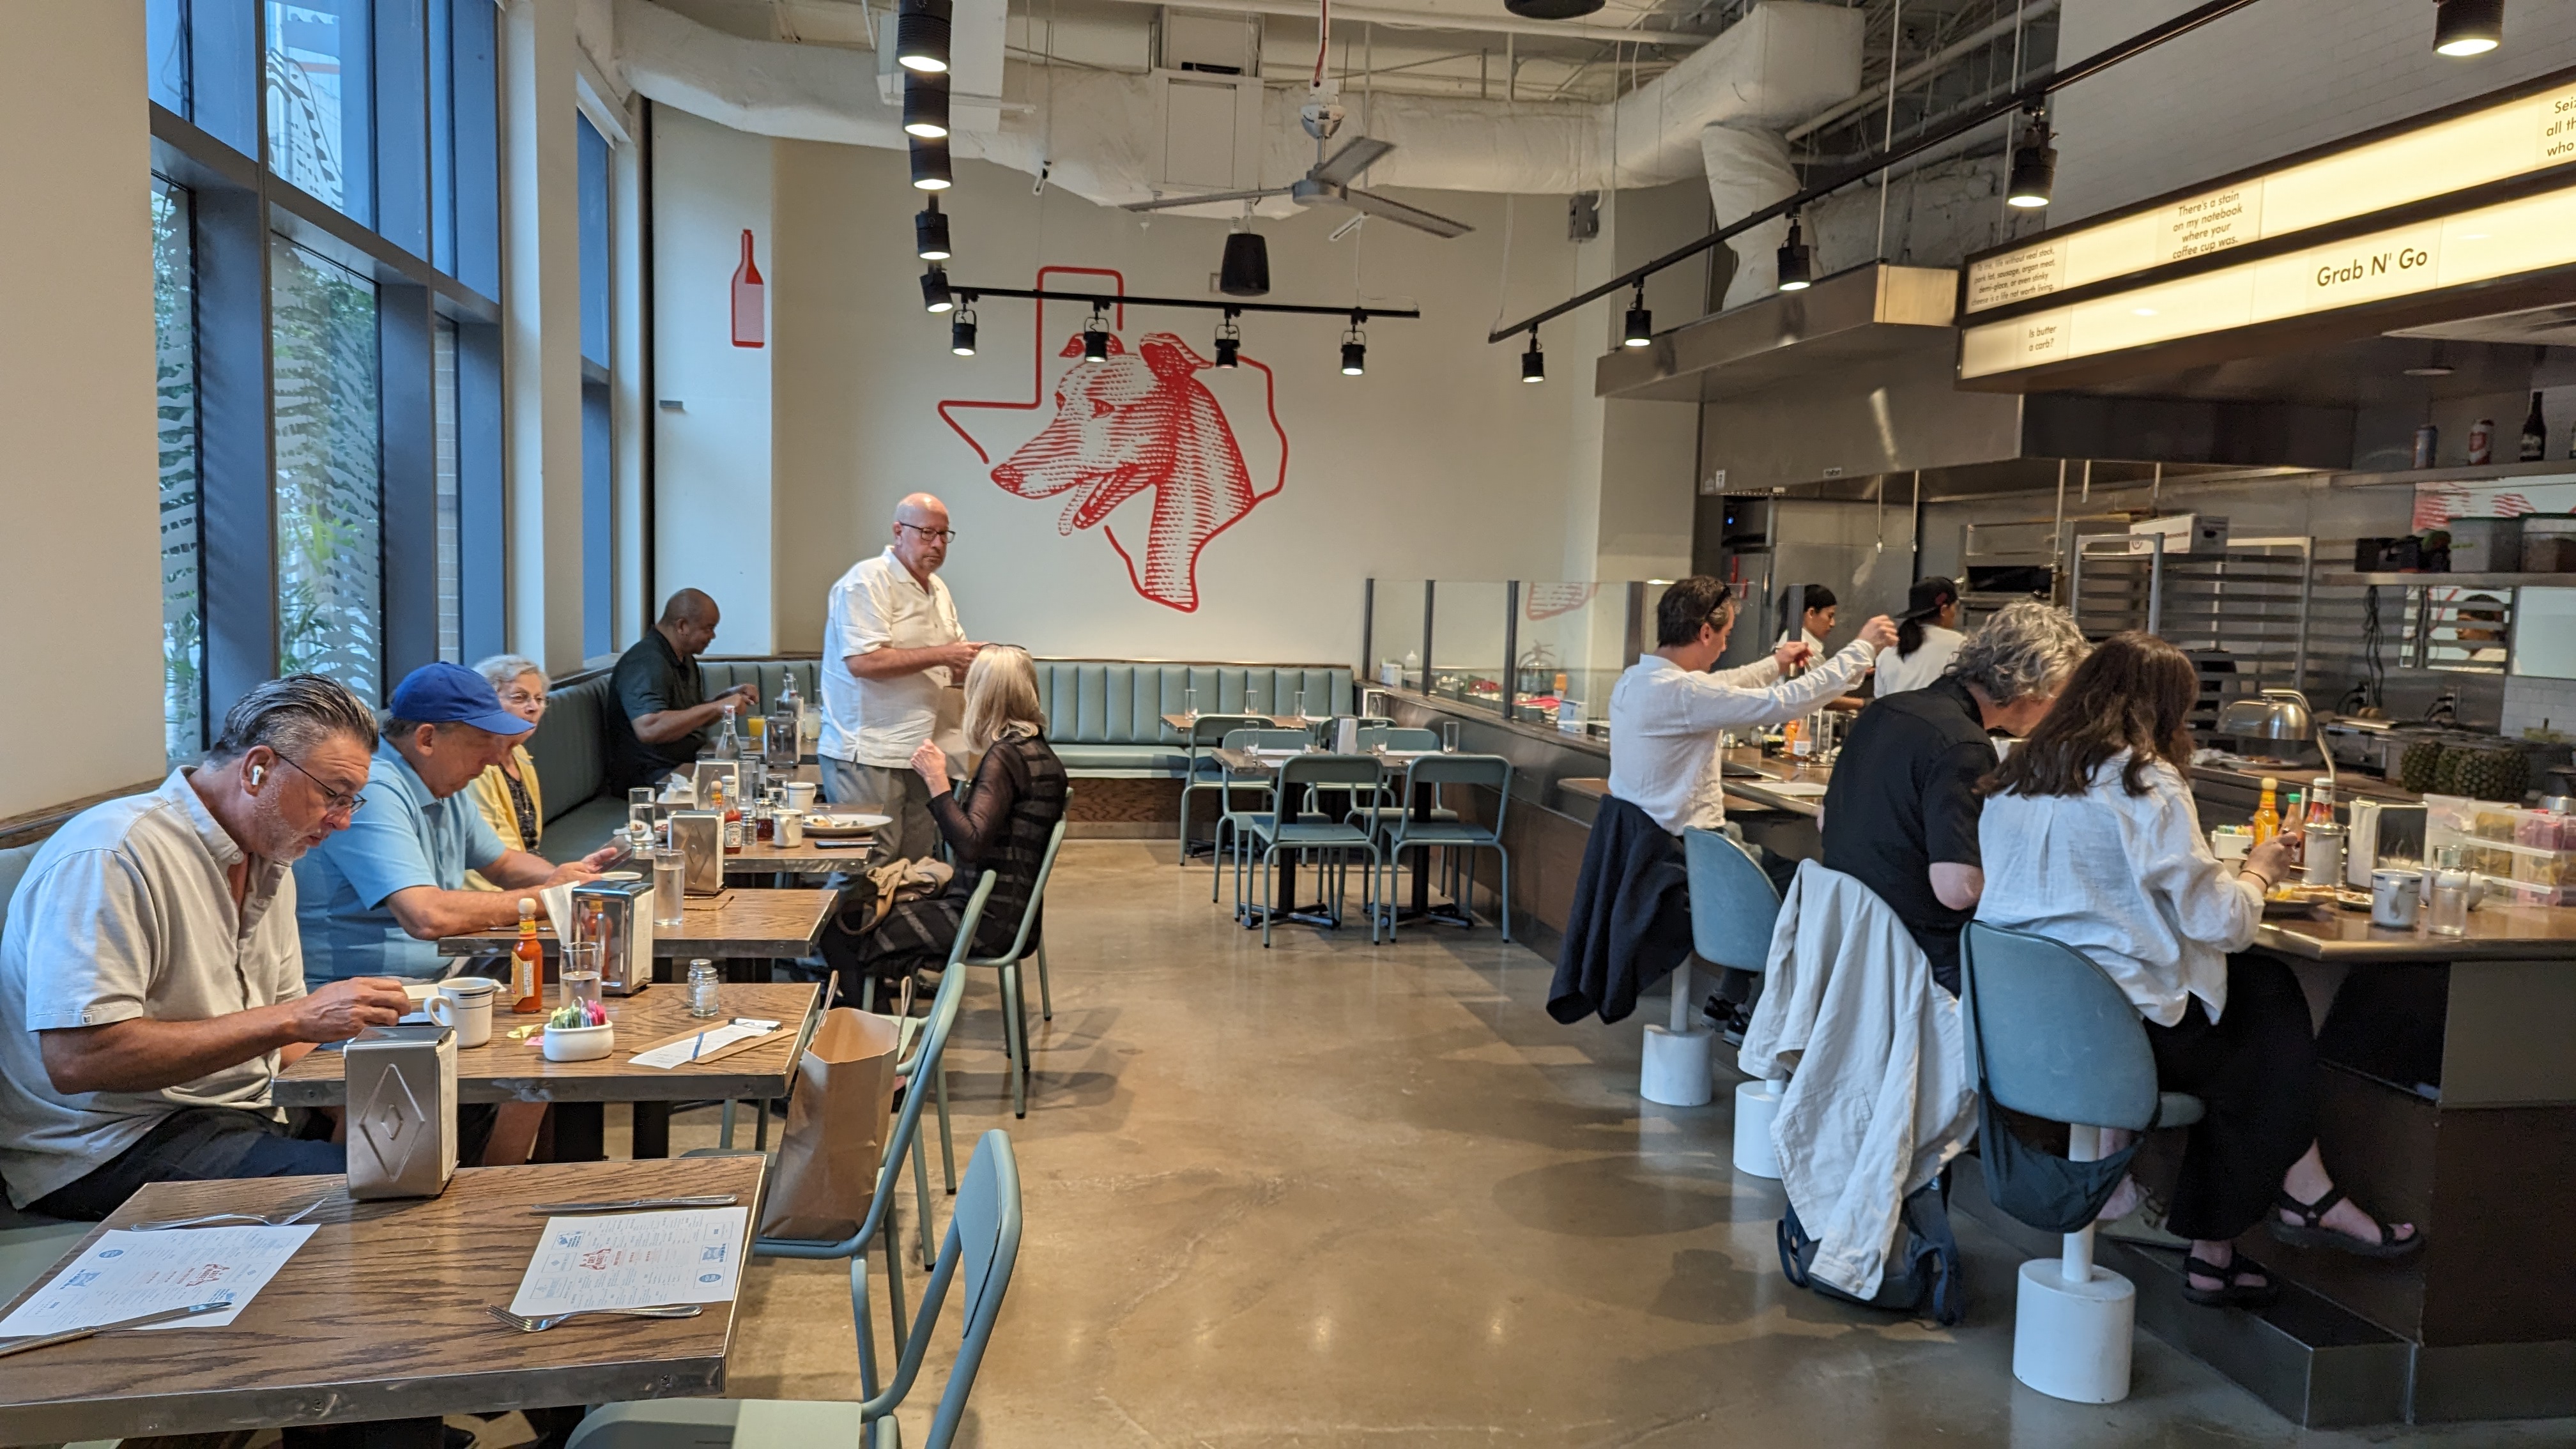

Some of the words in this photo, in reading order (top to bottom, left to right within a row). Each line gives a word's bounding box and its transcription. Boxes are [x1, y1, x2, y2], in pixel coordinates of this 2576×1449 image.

[2547, 121, 2561, 136] all
[2547, 141, 2574, 156] who
[2179, 201, 2207, 217] There's
[2218, 190, 2239, 205] stain
[2174, 223, 2184, 231] on
[2186, 218, 2199, 229] my
[2202, 203, 2242, 224] notebook
[2182, 230, 2208, 242] where
[2211, 223, 2231, 238] your
[1995, 259, 2003, 268] life
[2005, 255, 2024, 264] without
[2026, 249, 2037, 260] veal
[2039, 245, 2054, 256] stock,
[2173, 245, 2197, 259] coffee
[2200, 242, 2215, 252] cup
[2218, 236, 2238, 247] was.
[1974, 276, 1986, 284] pork
[1997, 268, 2020, 278] sausage,
[2022, 263, 2038, 273] organ
[2040, 259, 2055, 268] meat,
[2032, 272, 2048, 282] stinky
[2317, 259, 2363, 287] Grab
[2371, 253, 2392, 276] N'
[2399, 248, 2427, 269] Go
[1972, 297, 1988, 306] cheese
[2000, 291, 2009, 300] life
[2020, 286, 2035, 295] worth
[2037, 283, 2054, 291] living.
[2029, 329, 2034, 338] Is
[2037, 326, 2057, 336] butter
[2035, 338, 2054, 350] carb?
